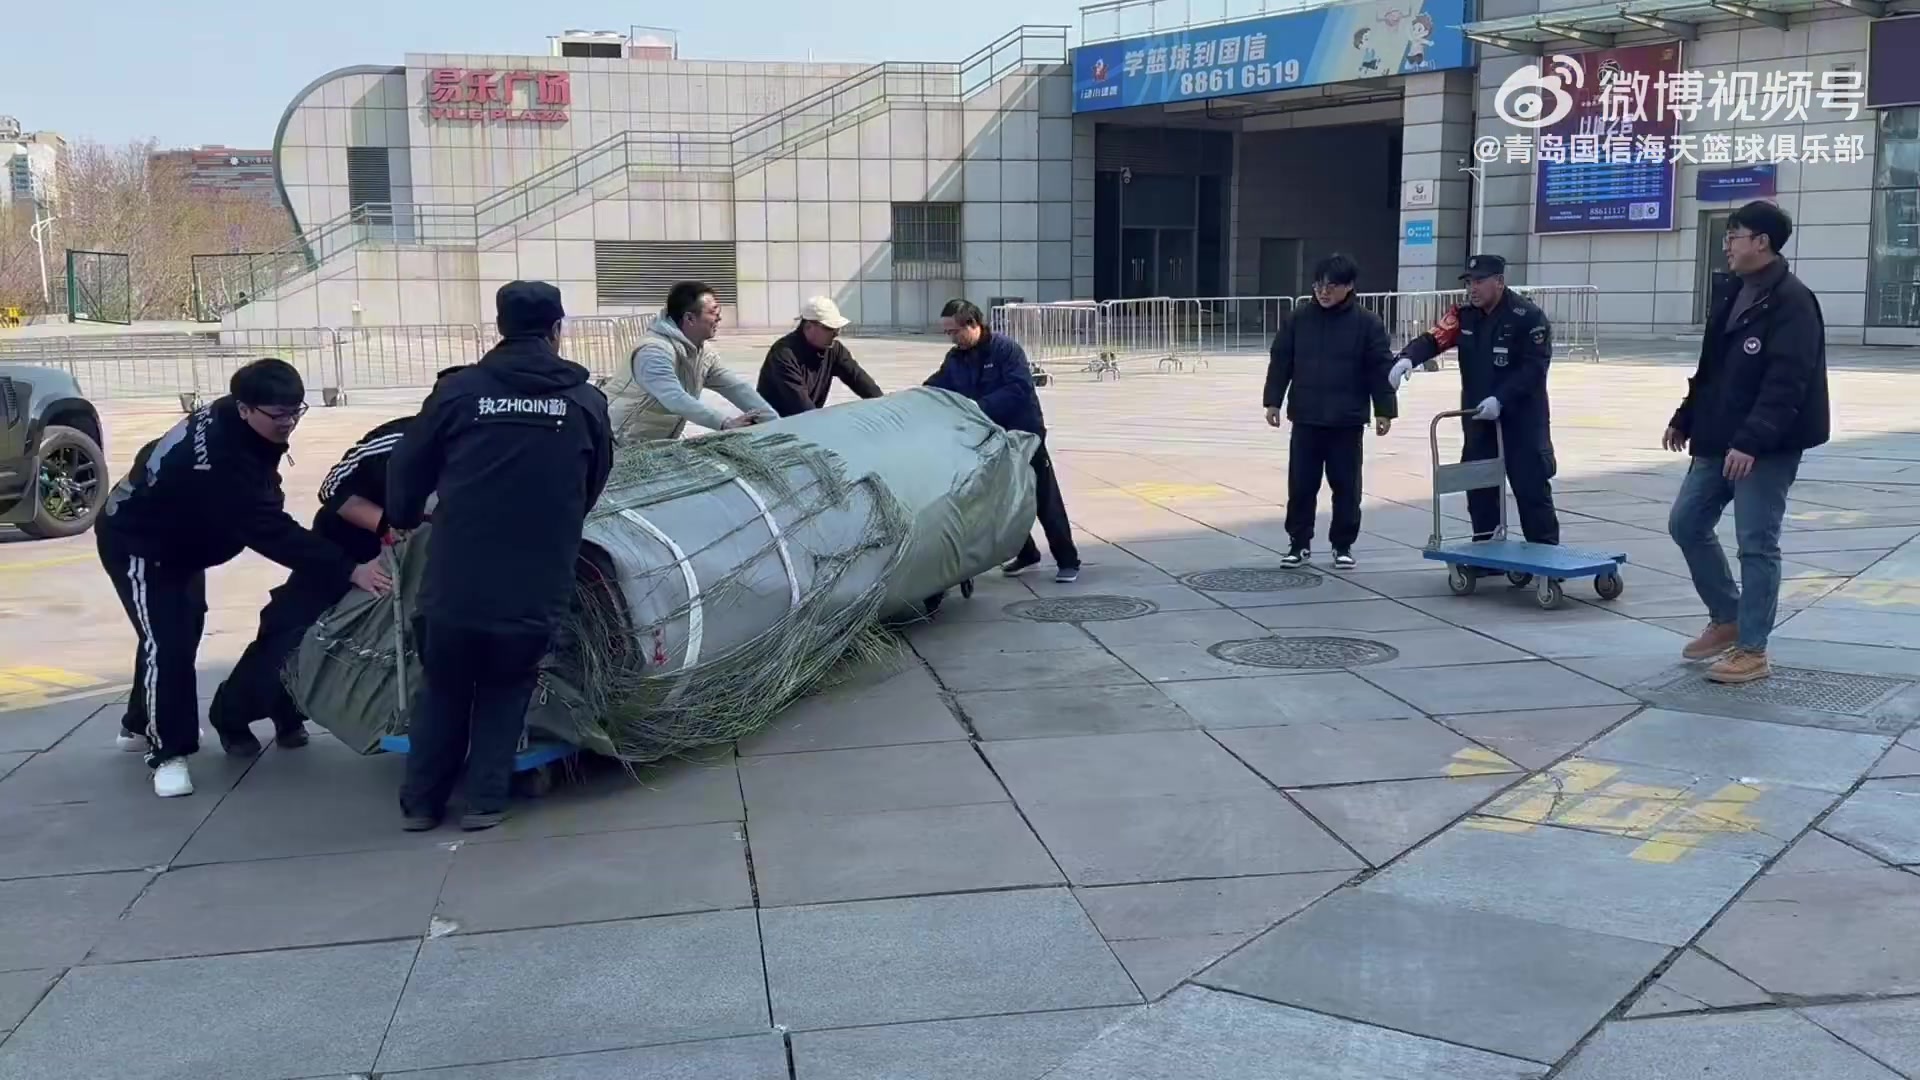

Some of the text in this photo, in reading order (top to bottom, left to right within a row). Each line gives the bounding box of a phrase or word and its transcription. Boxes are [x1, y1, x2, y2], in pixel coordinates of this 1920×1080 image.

[1123, 32, 1267, 77] 学篮球到国信
[431, 68, 571, 105] 易乐广场
[1180, 59, 1300, 95] 8861 6519
[428, 107, 570, 122] YILE PLAZA
[478, 397, 567, 416] 执ZHIQIN勤
